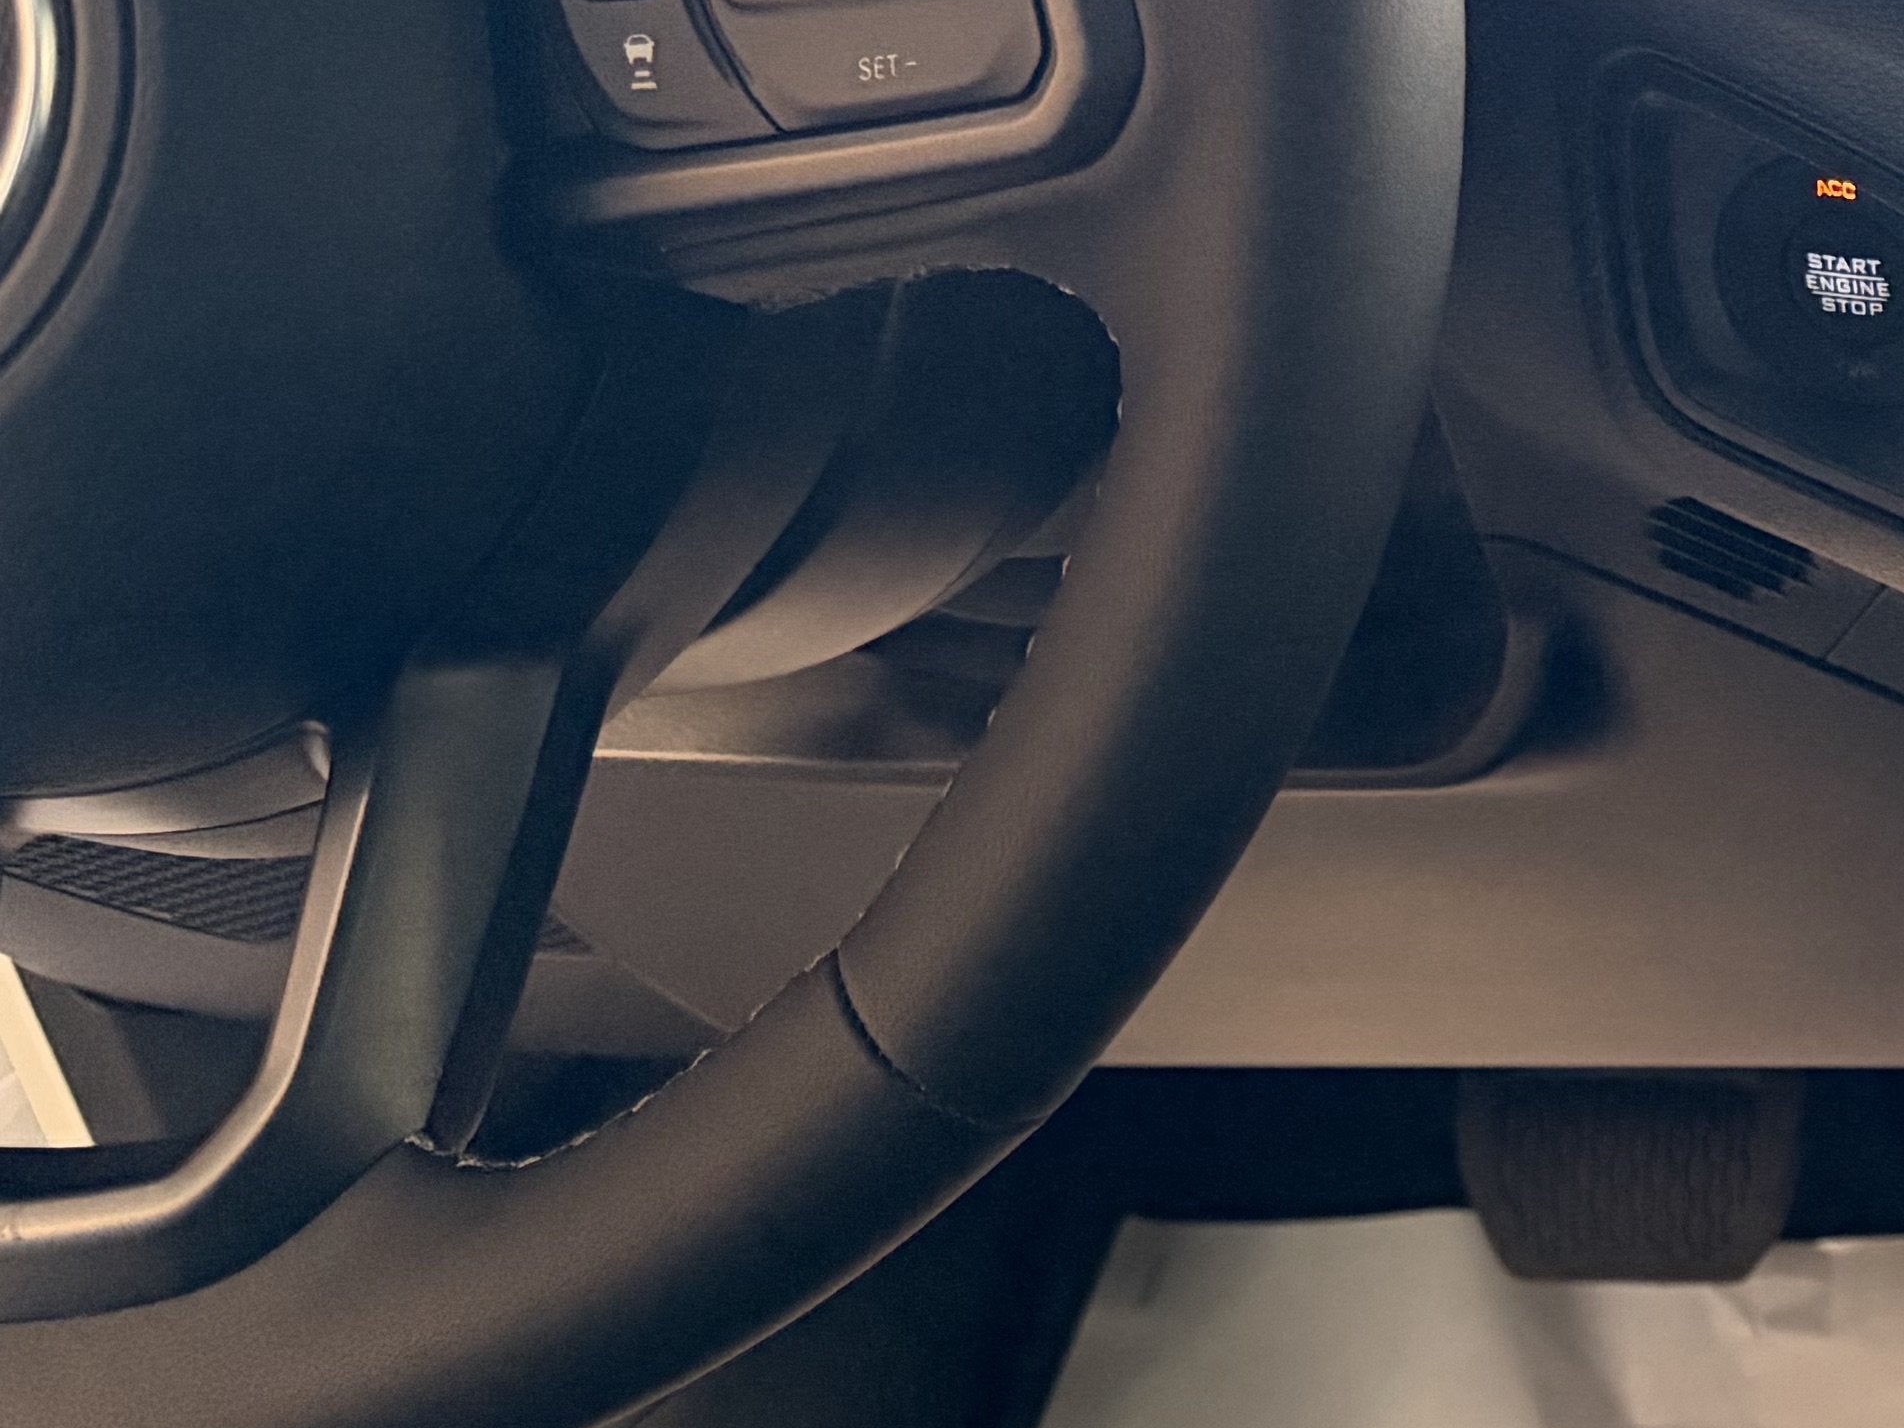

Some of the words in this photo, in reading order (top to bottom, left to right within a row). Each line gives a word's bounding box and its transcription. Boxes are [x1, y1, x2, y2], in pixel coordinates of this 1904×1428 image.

[1816, 179, 1857, 201] ACC
[1807, 252, 1881, 274] START
[1806, 275, 1890, 297] ENGINE
[1822, 298, 1884, 316] STOP
